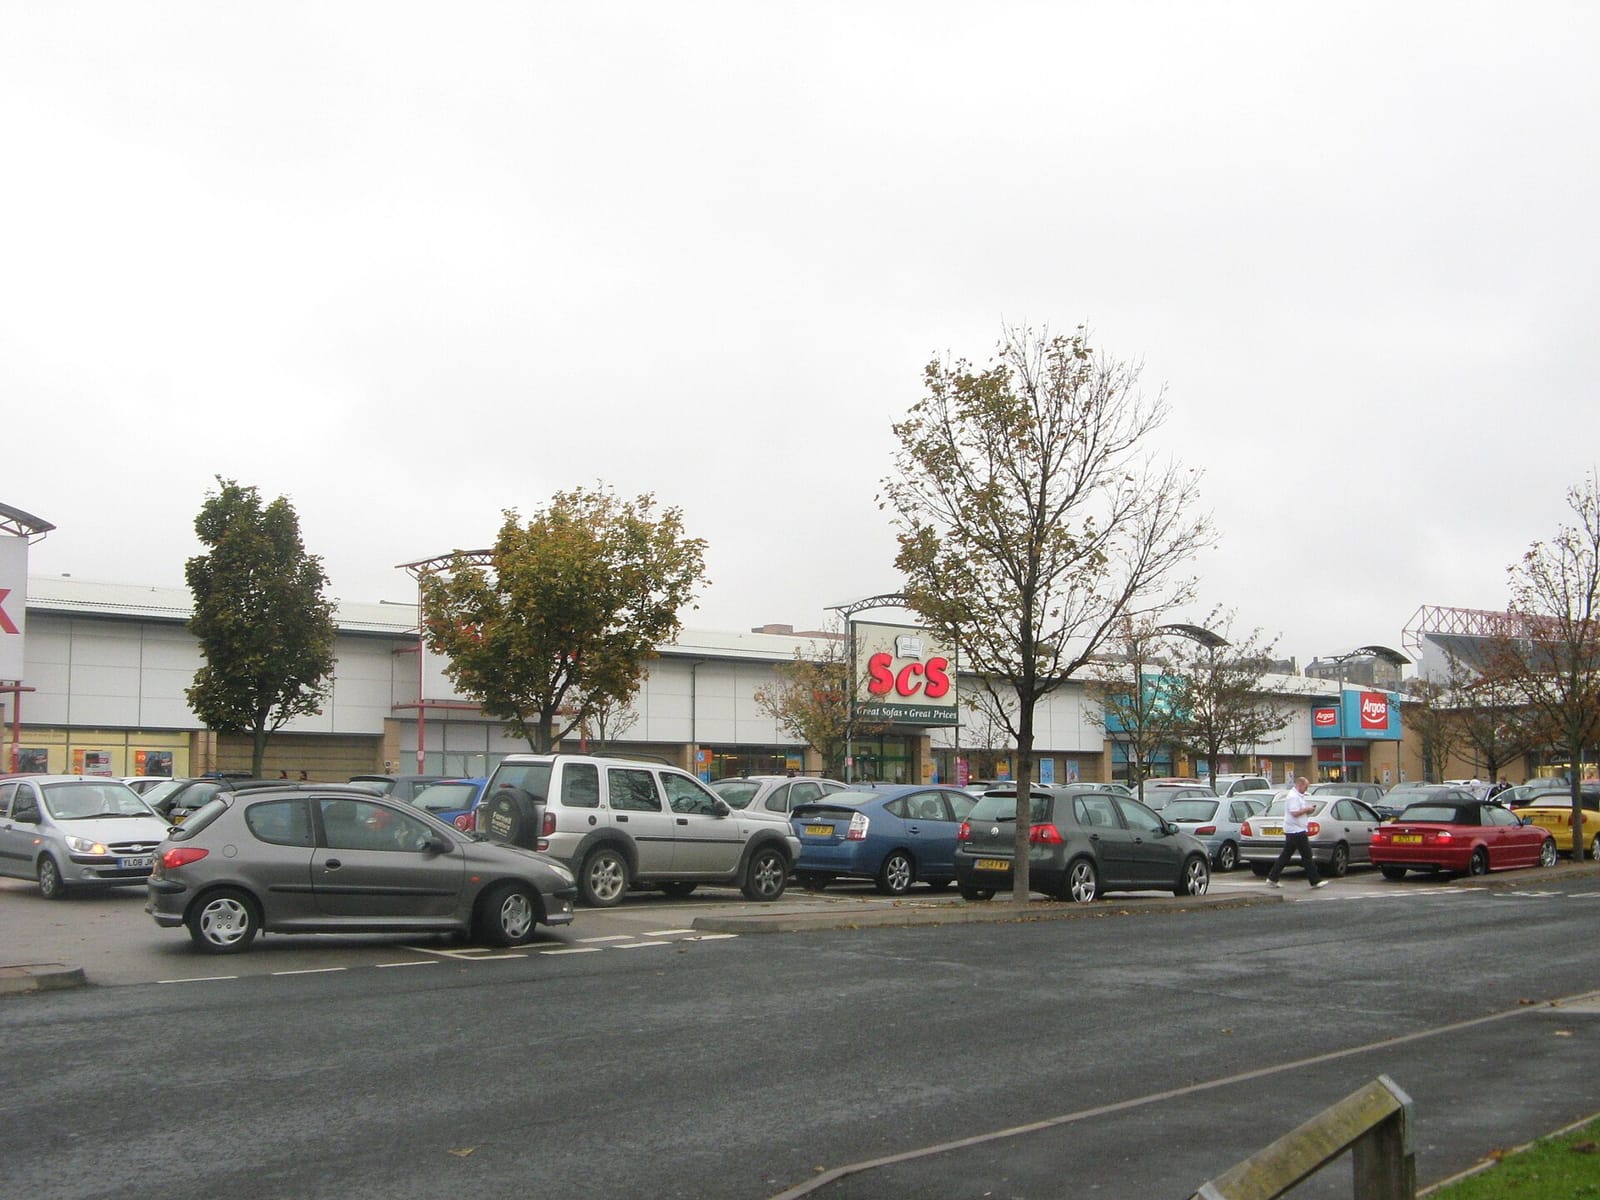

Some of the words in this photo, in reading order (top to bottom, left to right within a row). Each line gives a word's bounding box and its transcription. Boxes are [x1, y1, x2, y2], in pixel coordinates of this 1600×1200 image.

[868, 652, 950, 698] ScS
[882, 706, 903, 718] Sofas
[909, 708, 931, 718] Great
[933, 709, 957, 719] Prices
[1362, 698, 1386, 717] Argos
[1316, 711, 1335, 721] Argos
